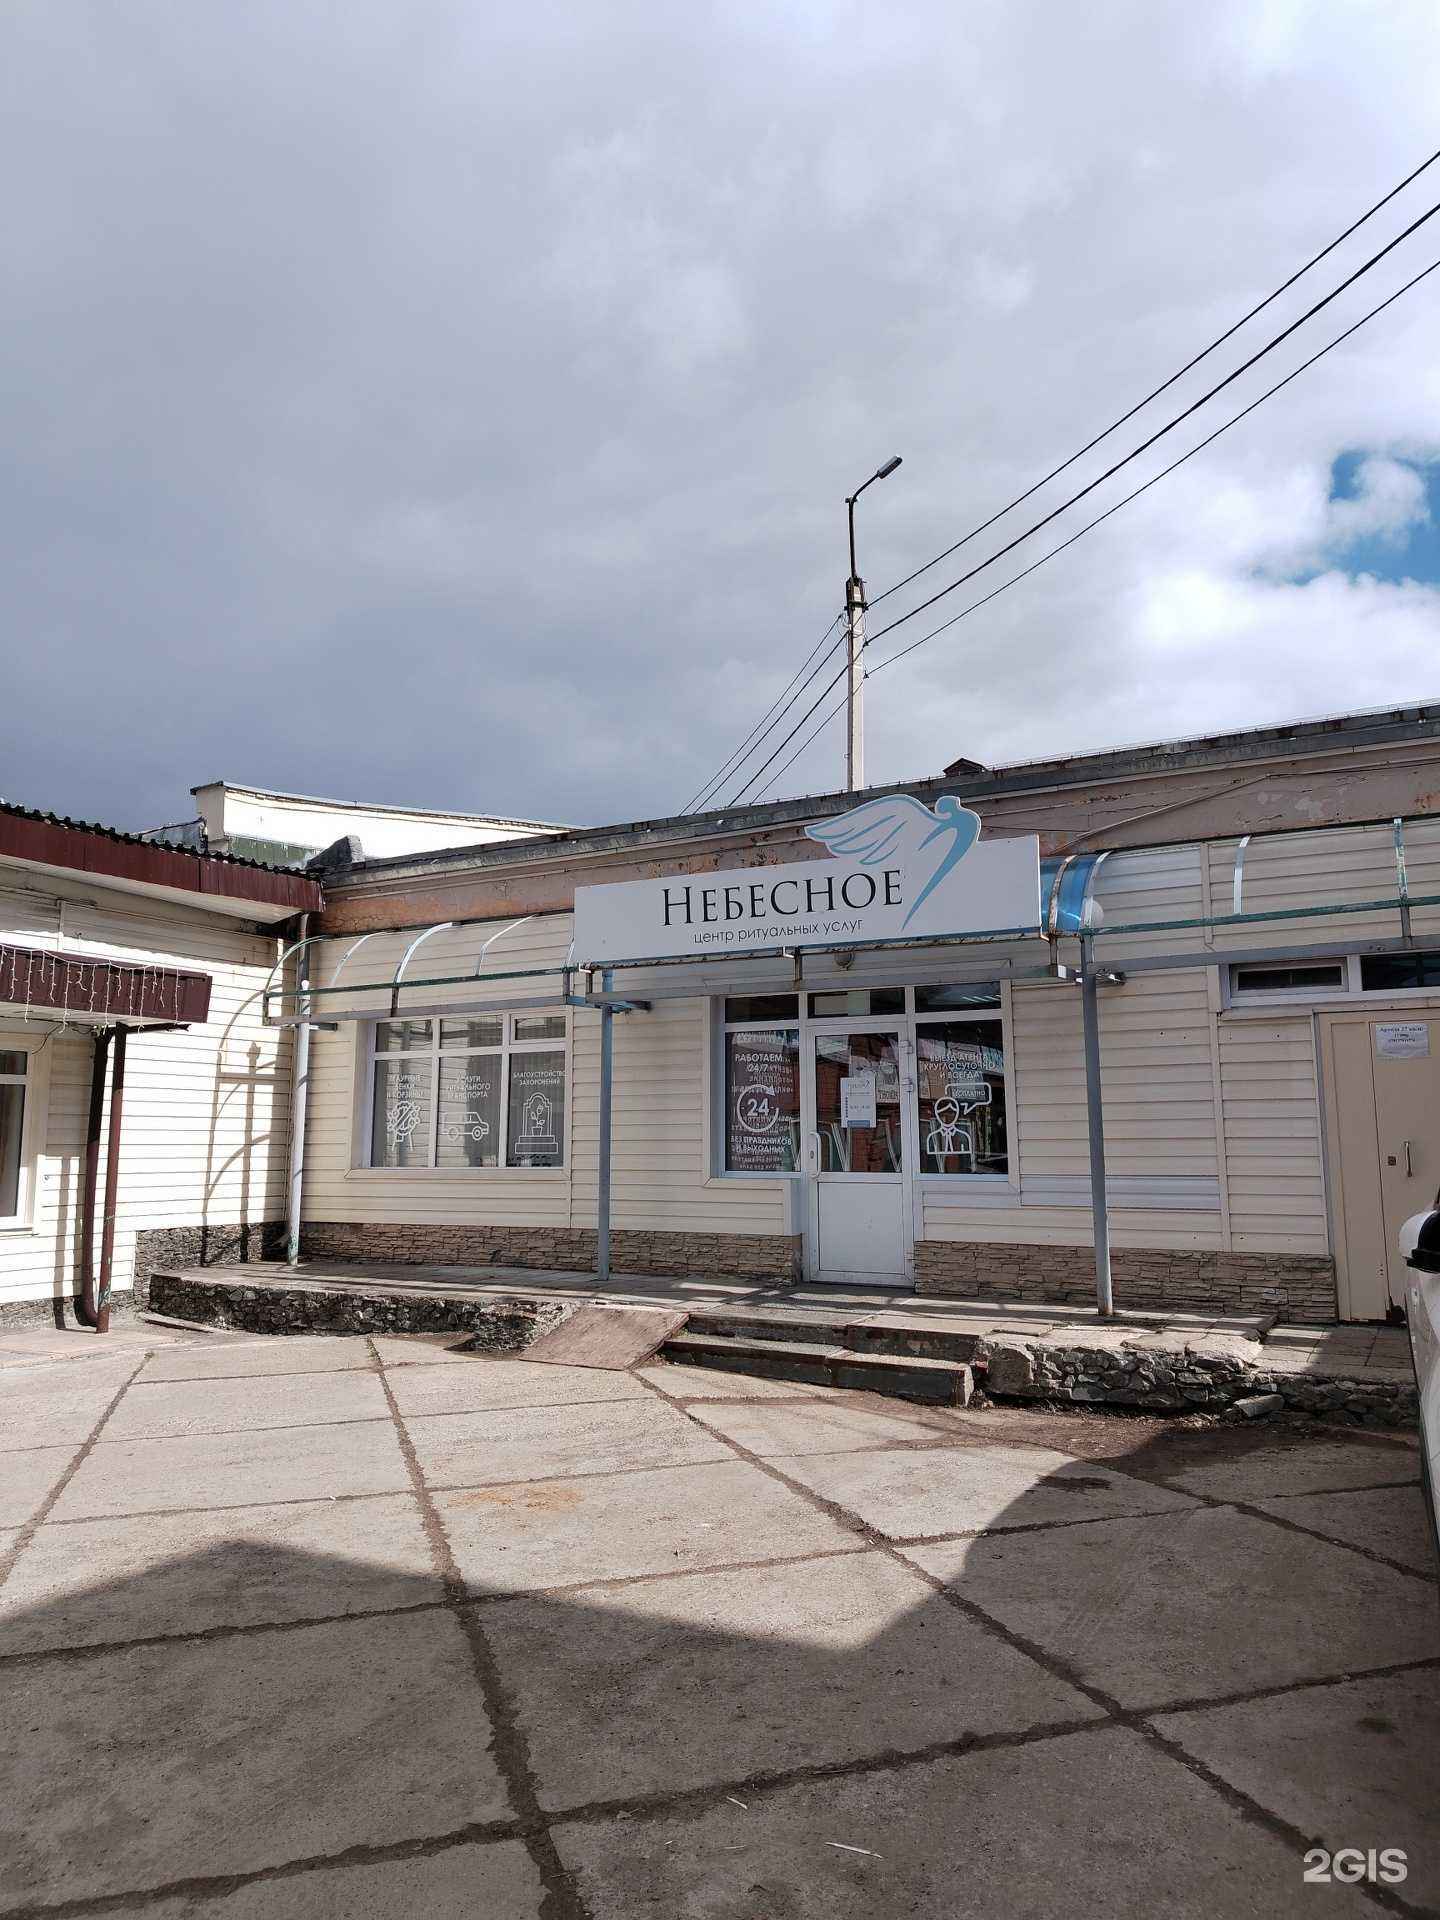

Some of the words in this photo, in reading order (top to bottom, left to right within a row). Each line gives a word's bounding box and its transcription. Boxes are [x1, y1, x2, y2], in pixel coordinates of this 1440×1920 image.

[663, 869, 903, 926] НЕБЕСНОЕ
[694, 929, 735, 944] центр
[738, 924, 820, 942] ритуальных
[823, 919, 863, 935] услуг
[735, 1053, 783, 1062] РАБОТАЕМ
[747, 1063, 769, 1073] 24/7
[747, 1098, 770, 1116] 24
